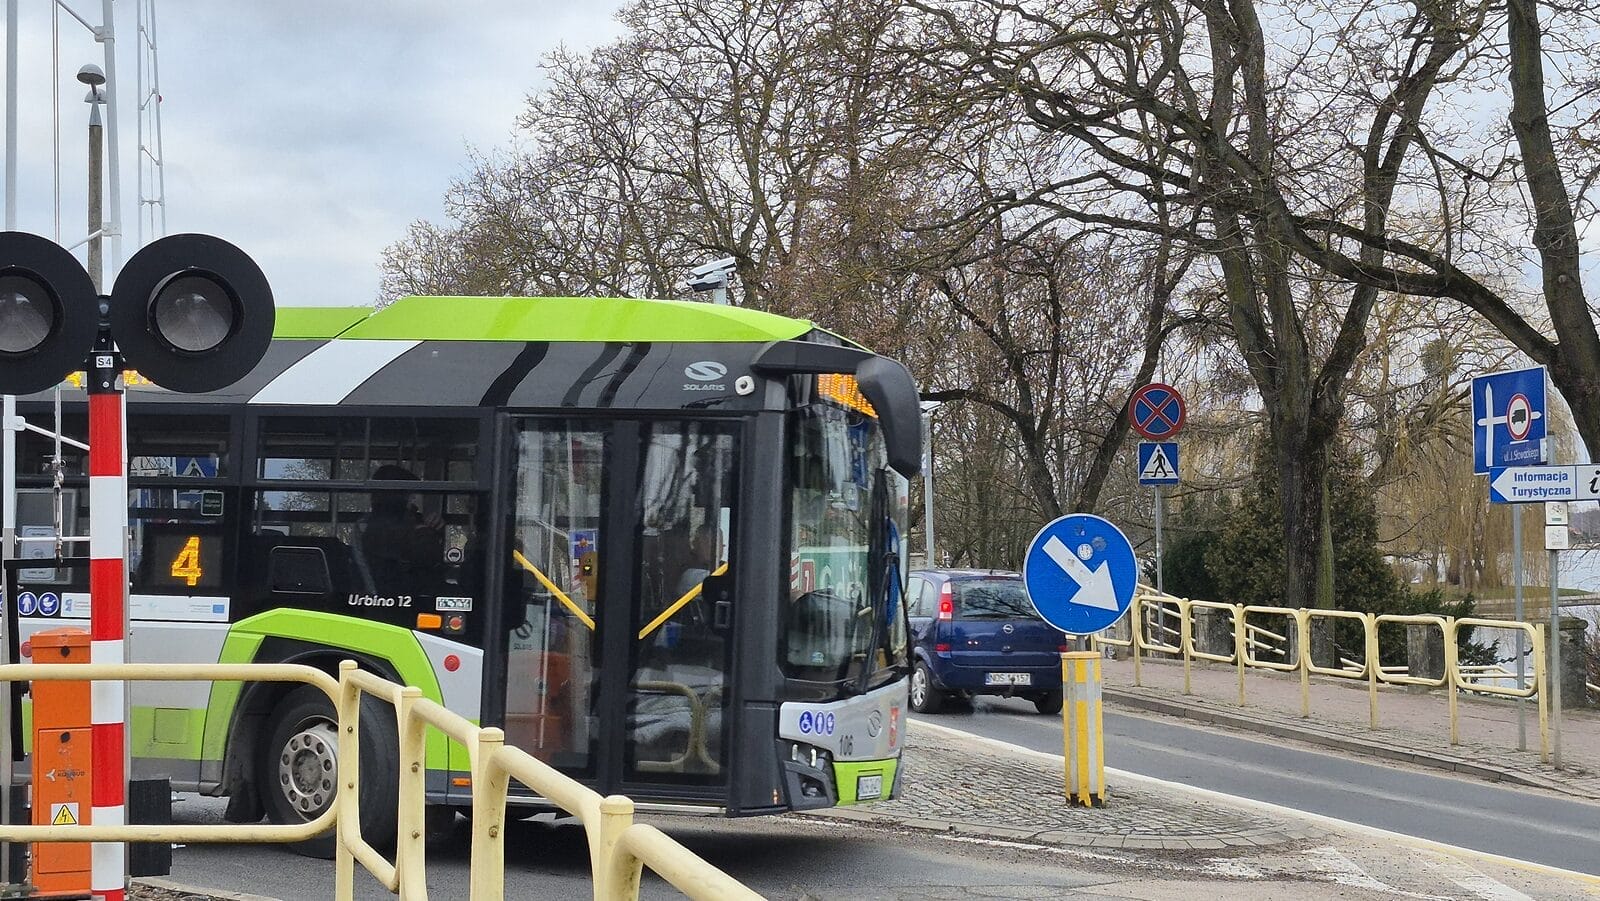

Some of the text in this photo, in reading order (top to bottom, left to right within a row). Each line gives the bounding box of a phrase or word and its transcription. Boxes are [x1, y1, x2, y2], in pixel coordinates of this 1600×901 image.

[97, 357, 112, 366] S4
[682, 383, 726, 392] SOLARIS
[1514, 472, 1568, 483] Informacja
[1511, 486, 1571, 498] Turystyczna
[171, 536, 202, 587] 4
[348, 594, 412, 607] Urbino 12
[839, 734, 854, 756] 106
